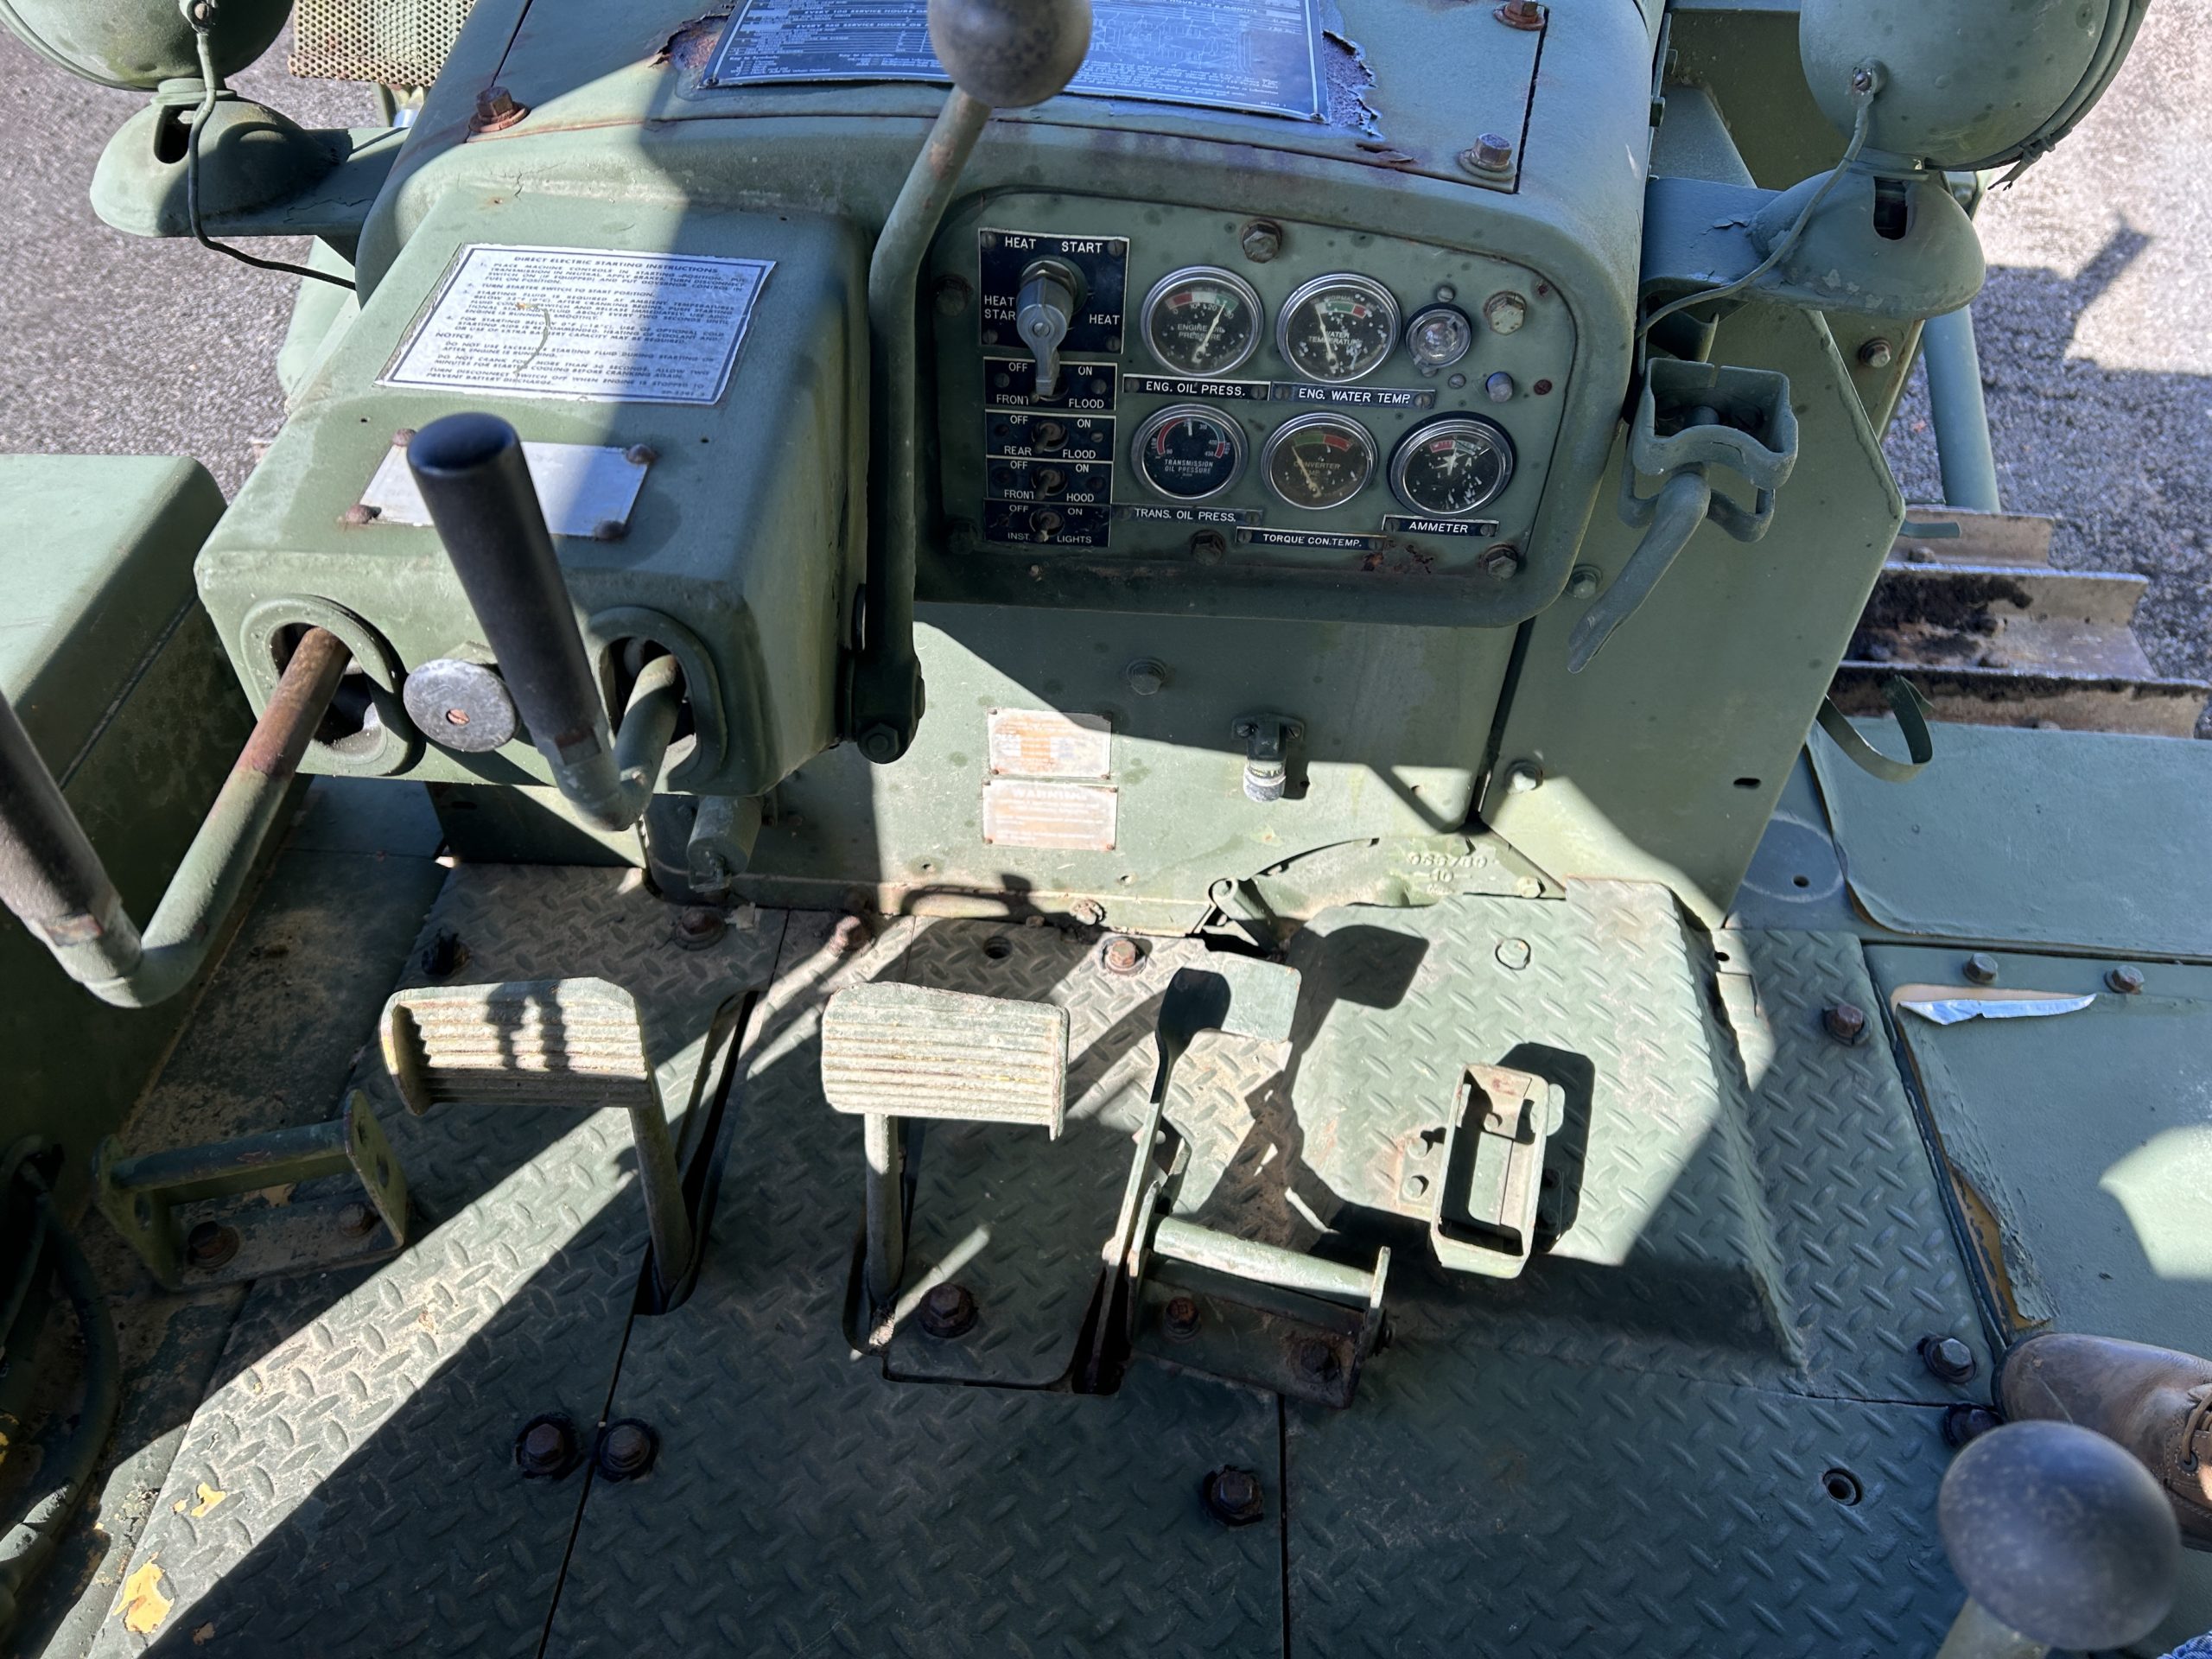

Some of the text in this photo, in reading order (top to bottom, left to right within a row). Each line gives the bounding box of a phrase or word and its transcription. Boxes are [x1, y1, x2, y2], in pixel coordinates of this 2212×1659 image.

[1005, 237, 1036, 249] HEAT
[1061, 242, 1103, 254] START
[645, 264, 718, 272] INSTRUCTIONS
[984, 295, 1014, 307] HEAT
[984, 309, 1016, 321] STAR
[1089, 315, 1120, 325] HEAT
[1177, 323, 1208, 332] ENGINE
[1179, 331, 1222, 340] PRESSRE
[1008, 362, 1028, 372] OFF
[1078, 366, 1092, 377] ON
[1146, 381, 1246, 397] ENG. OIL PRESS.
[1299, 388, 1412, 404] ENG. WATER TEMP.
[1069, 398, 1104, 410] FLOOD
[1010, 415, 1028, 425] OFF
[1077, 418, 1091, 429] ON
[1004, 446, 1096, 460] REAR FLOOD
[1010, 461, 1028, 470] OFF
[1165, 459, 1213, 468] TRANSMISSION
[1293, 461, 1341, 470] CNVERTER
[1465, 458, 1472, 467] A
[1075, 463, 1089, 474] ON
[1066, 493, 1094, 503] HOOD
[1009, 505, 1028, 513] OFF
[1135, 508, 1237, 522] TRANS. OIL PRESS.
[1408, 521, 1469, 533] AMMETER
[1007, 532, 1092, 544] INST. LIGHTS
[1263, 533, 1305, 544] TORQUE
